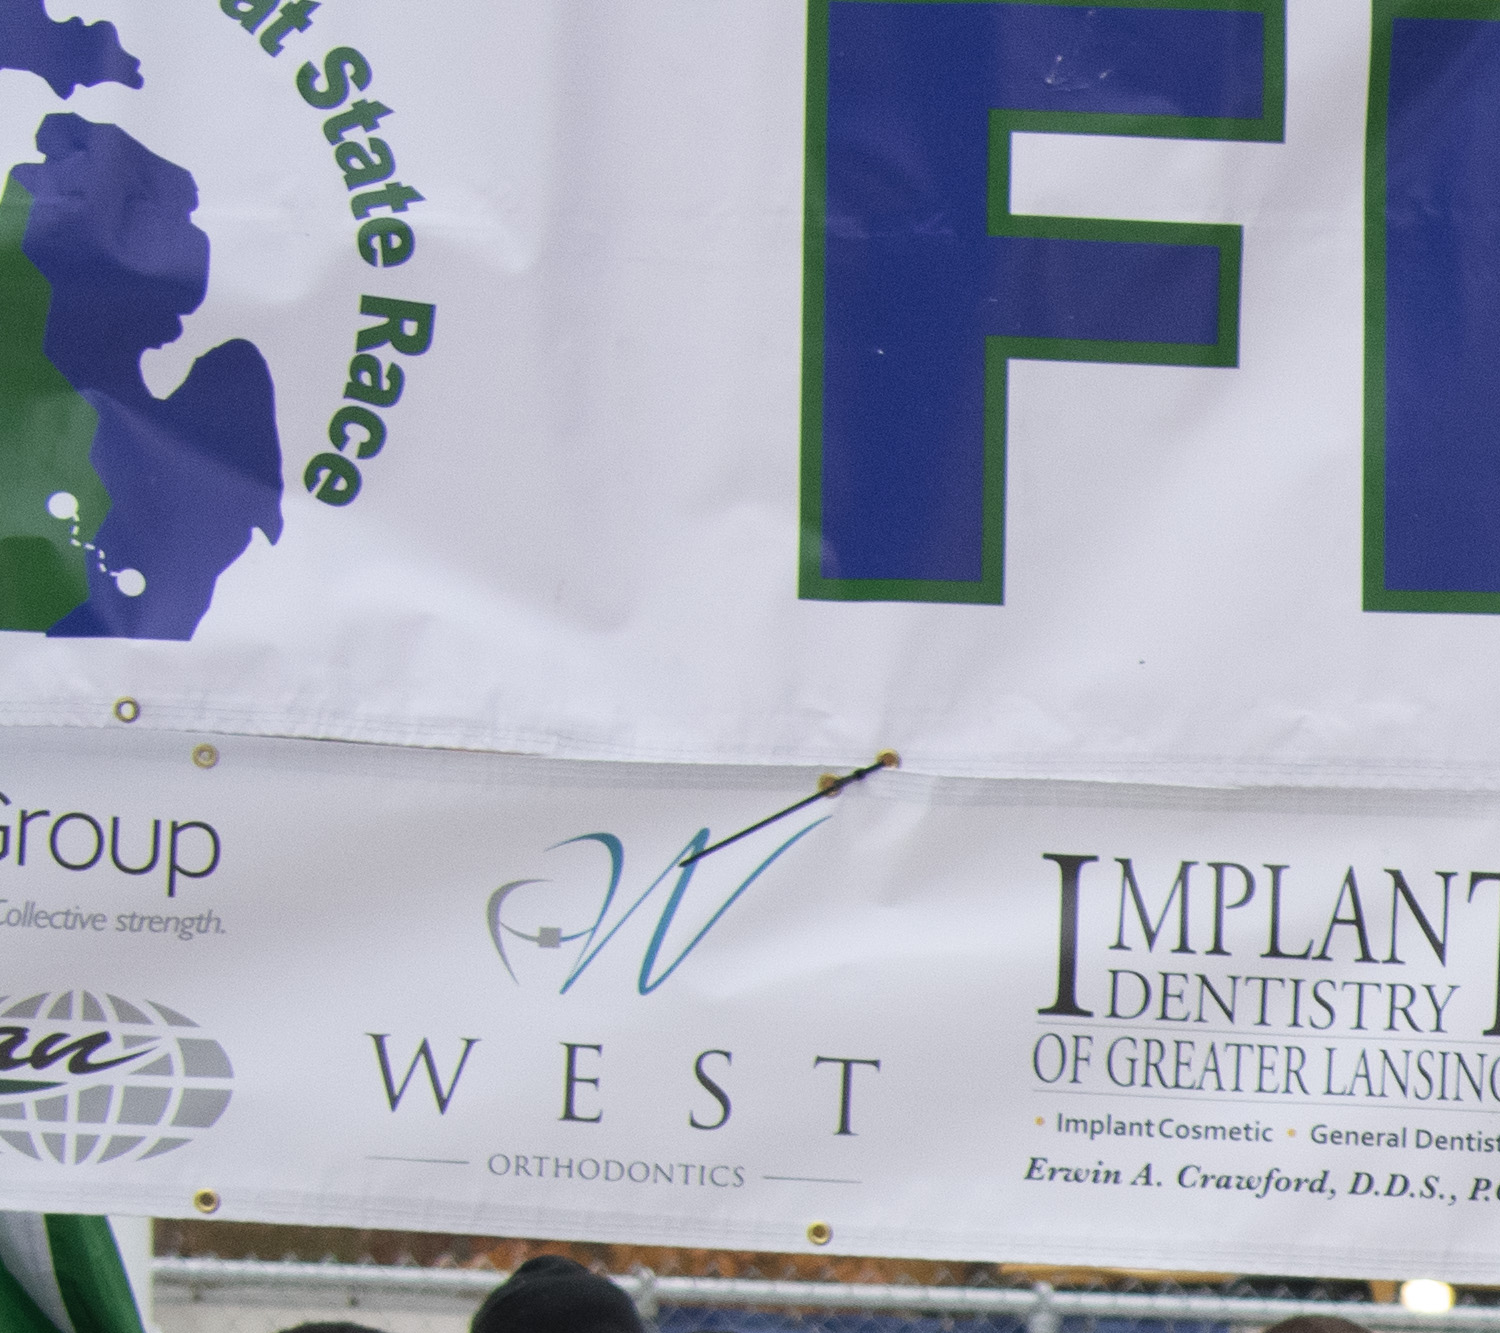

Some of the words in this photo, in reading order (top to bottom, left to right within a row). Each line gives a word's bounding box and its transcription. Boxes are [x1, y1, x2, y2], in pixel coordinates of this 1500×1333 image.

[296, 47, 426, 267] State
[303, 294, 436, 506] Race
[115, 908, 227, 941] strength.
[1105, 969, 1460, 1034] DENTISTRY
[366, 1032, 882, 1137] WEST
[1032, 1033, 1094, 1085] OF
[1107, 1036, 1310, 1096] GREATER
[1055, 1112, 1155, 1142] Implant
[1159, 1116, 1274, 1144] Cosmetic
[1310, 1123, 1406, 1151] General
[487, 1152, 746, 1190] ORTHODONTICS
[1024, 1157, 1122, 1187] Erwin
[1131, 1163, 1162, 1188] A.
[1177, 1163, 1337, 1200] Crawford,
[1348, 1172, 1457, 1206] D.D.S.,
